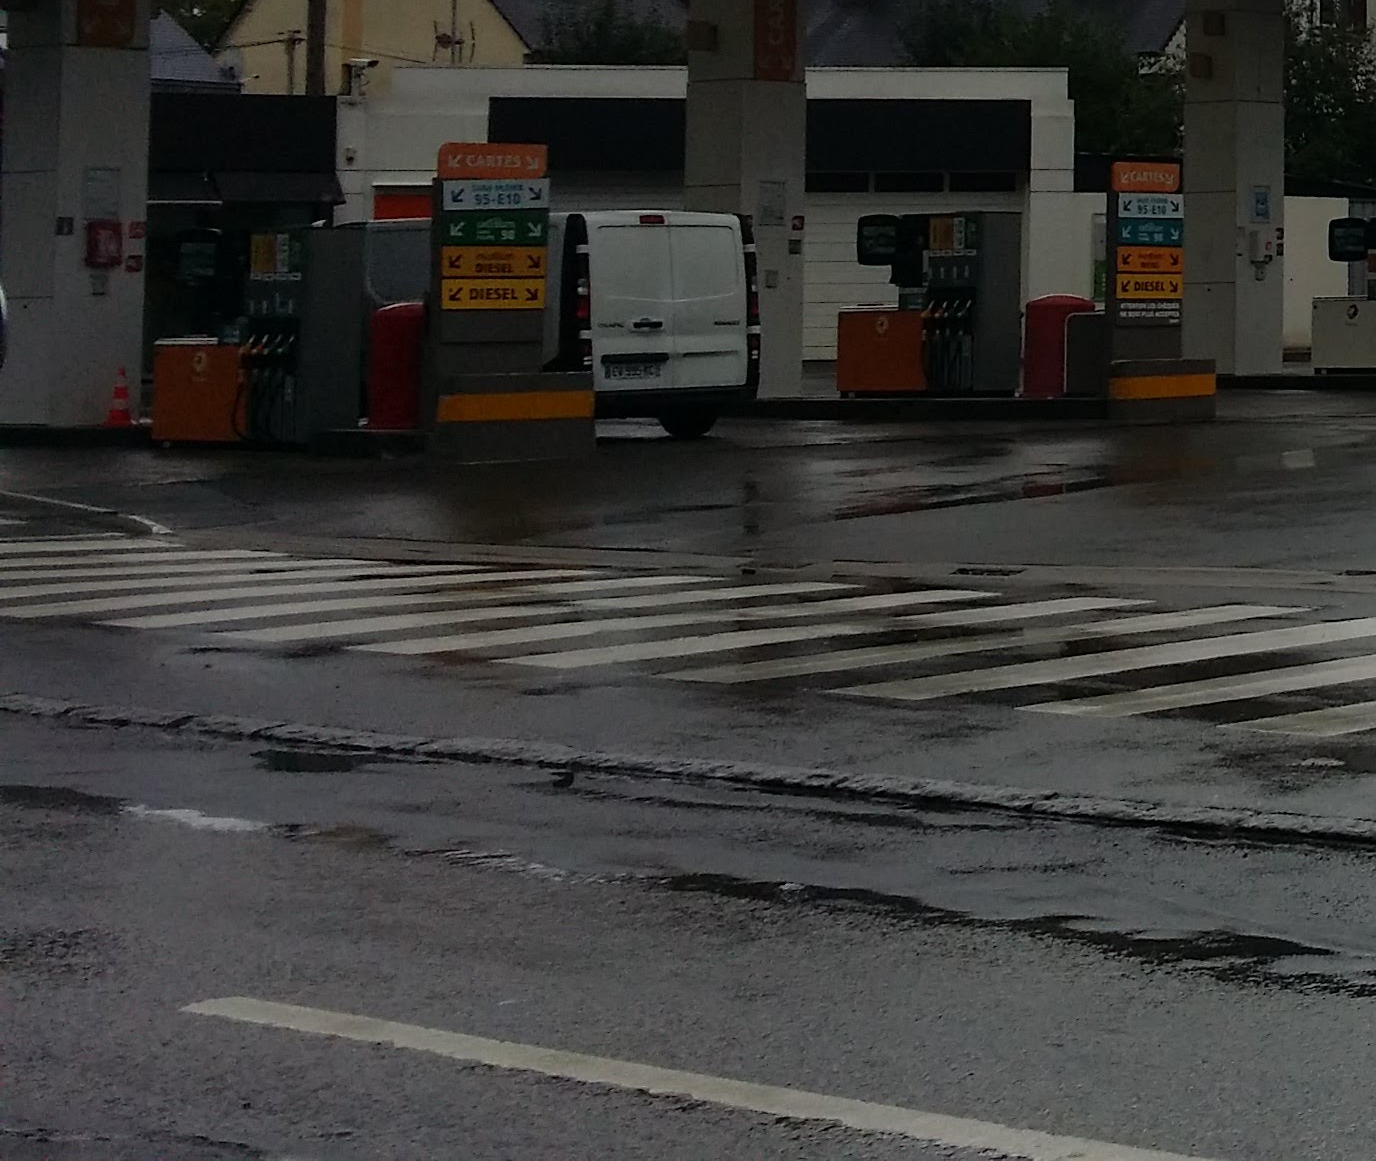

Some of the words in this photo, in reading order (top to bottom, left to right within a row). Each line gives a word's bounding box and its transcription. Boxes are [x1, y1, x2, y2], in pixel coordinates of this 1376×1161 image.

[474, 193, 522, 205] 95-E10
[1134, 281, 1165, 292] DIESEL
[469, 288, 518, 300] DIESEL
